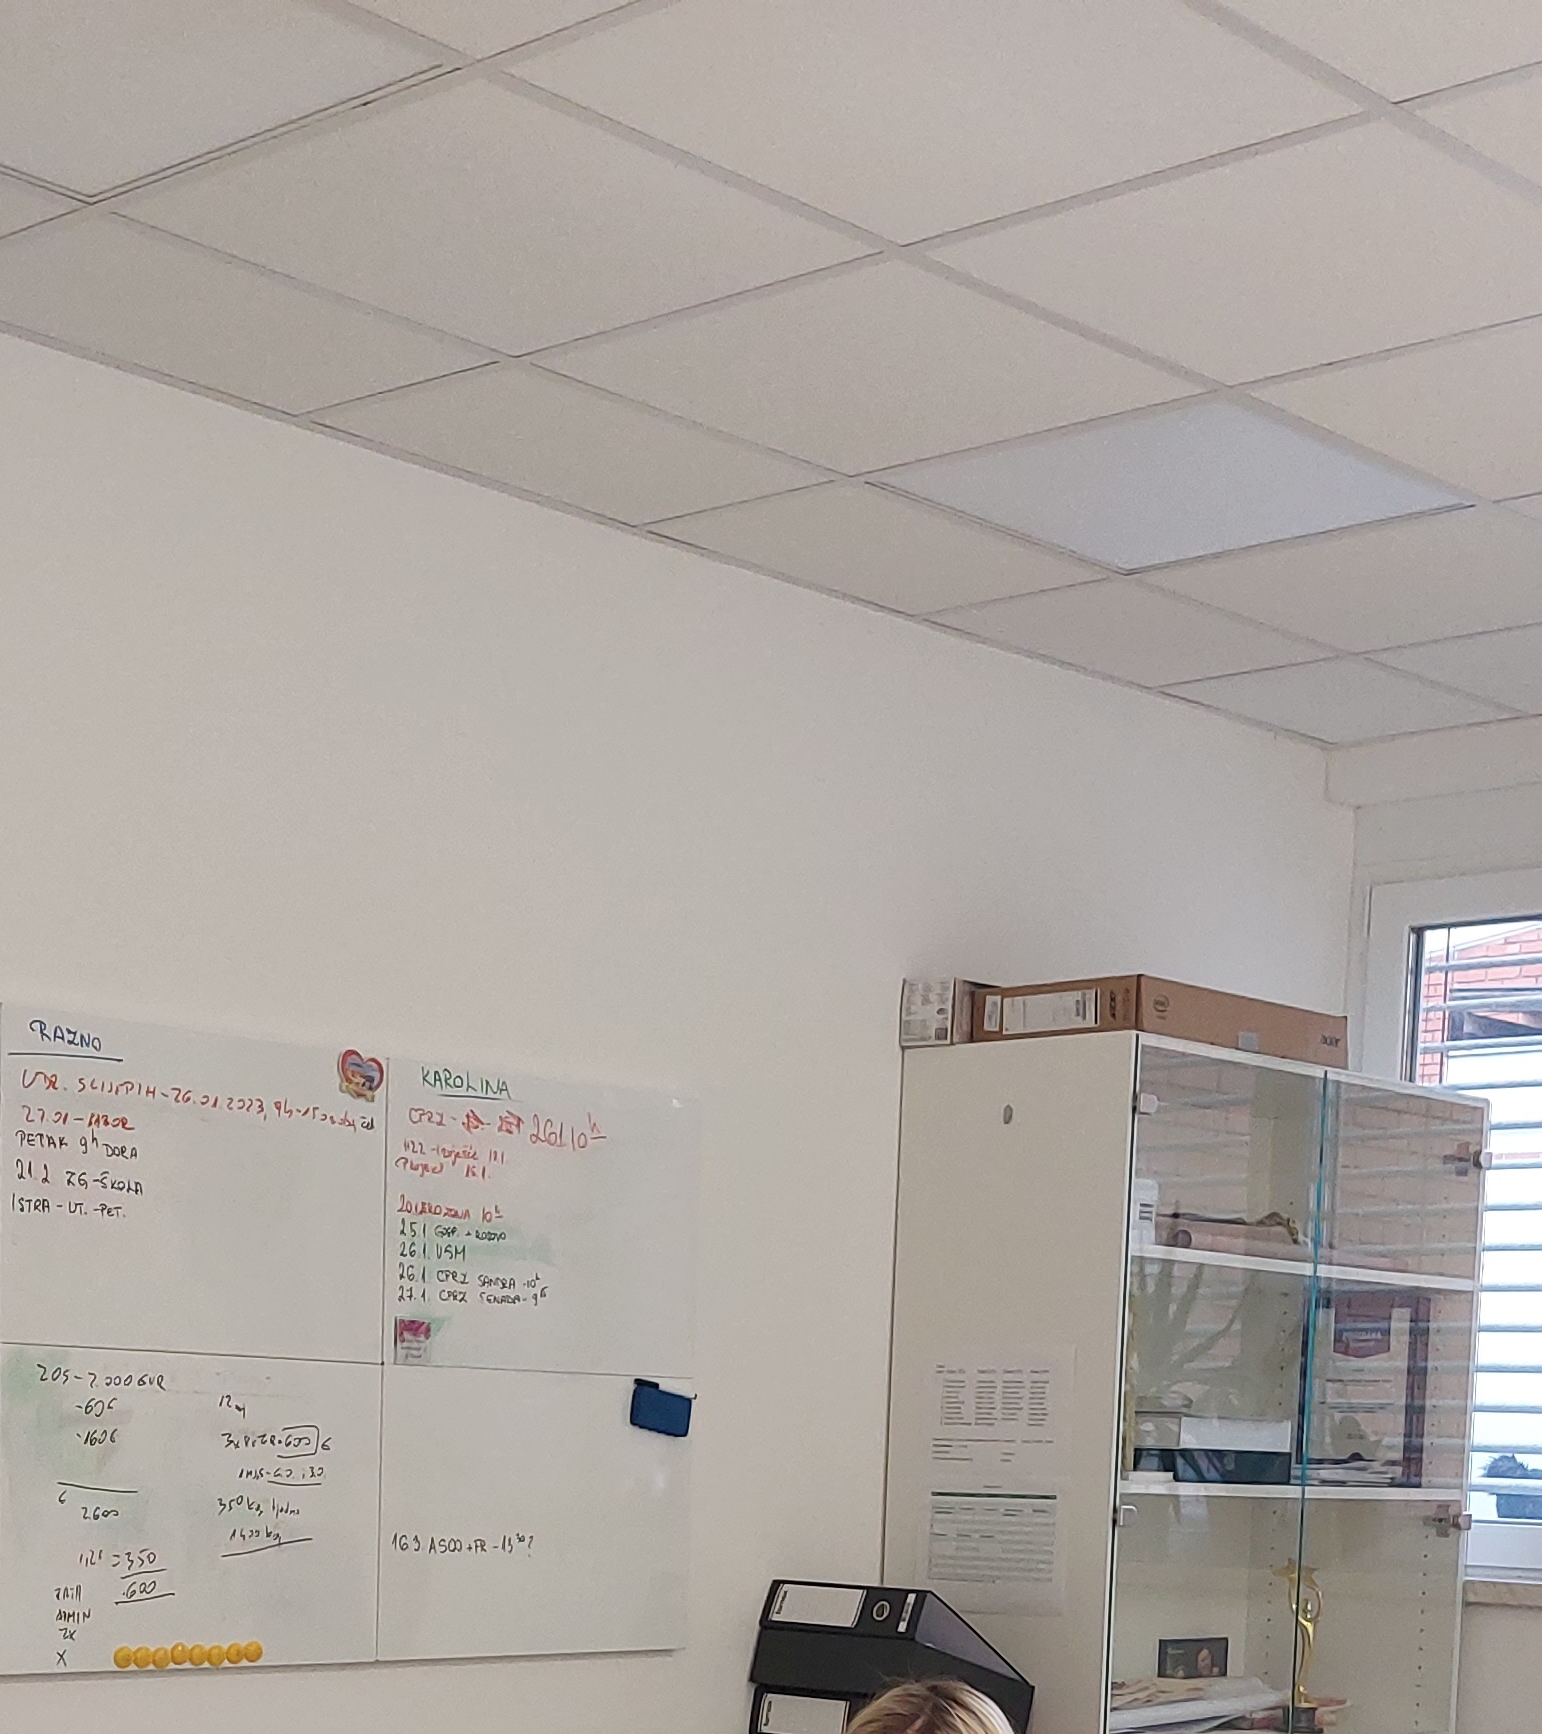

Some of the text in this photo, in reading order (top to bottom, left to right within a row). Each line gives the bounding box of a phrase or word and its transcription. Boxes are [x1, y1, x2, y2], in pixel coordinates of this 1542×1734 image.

[29, 1019, 102, 1052] RAZNO
[421, 1066, 512, 1100] KAROLINA
[15, 1129, 68, 1149] PETAK
[101, 1143, 138, 1160] DORA
[11, 1192, 51, 1213] ISTRA
